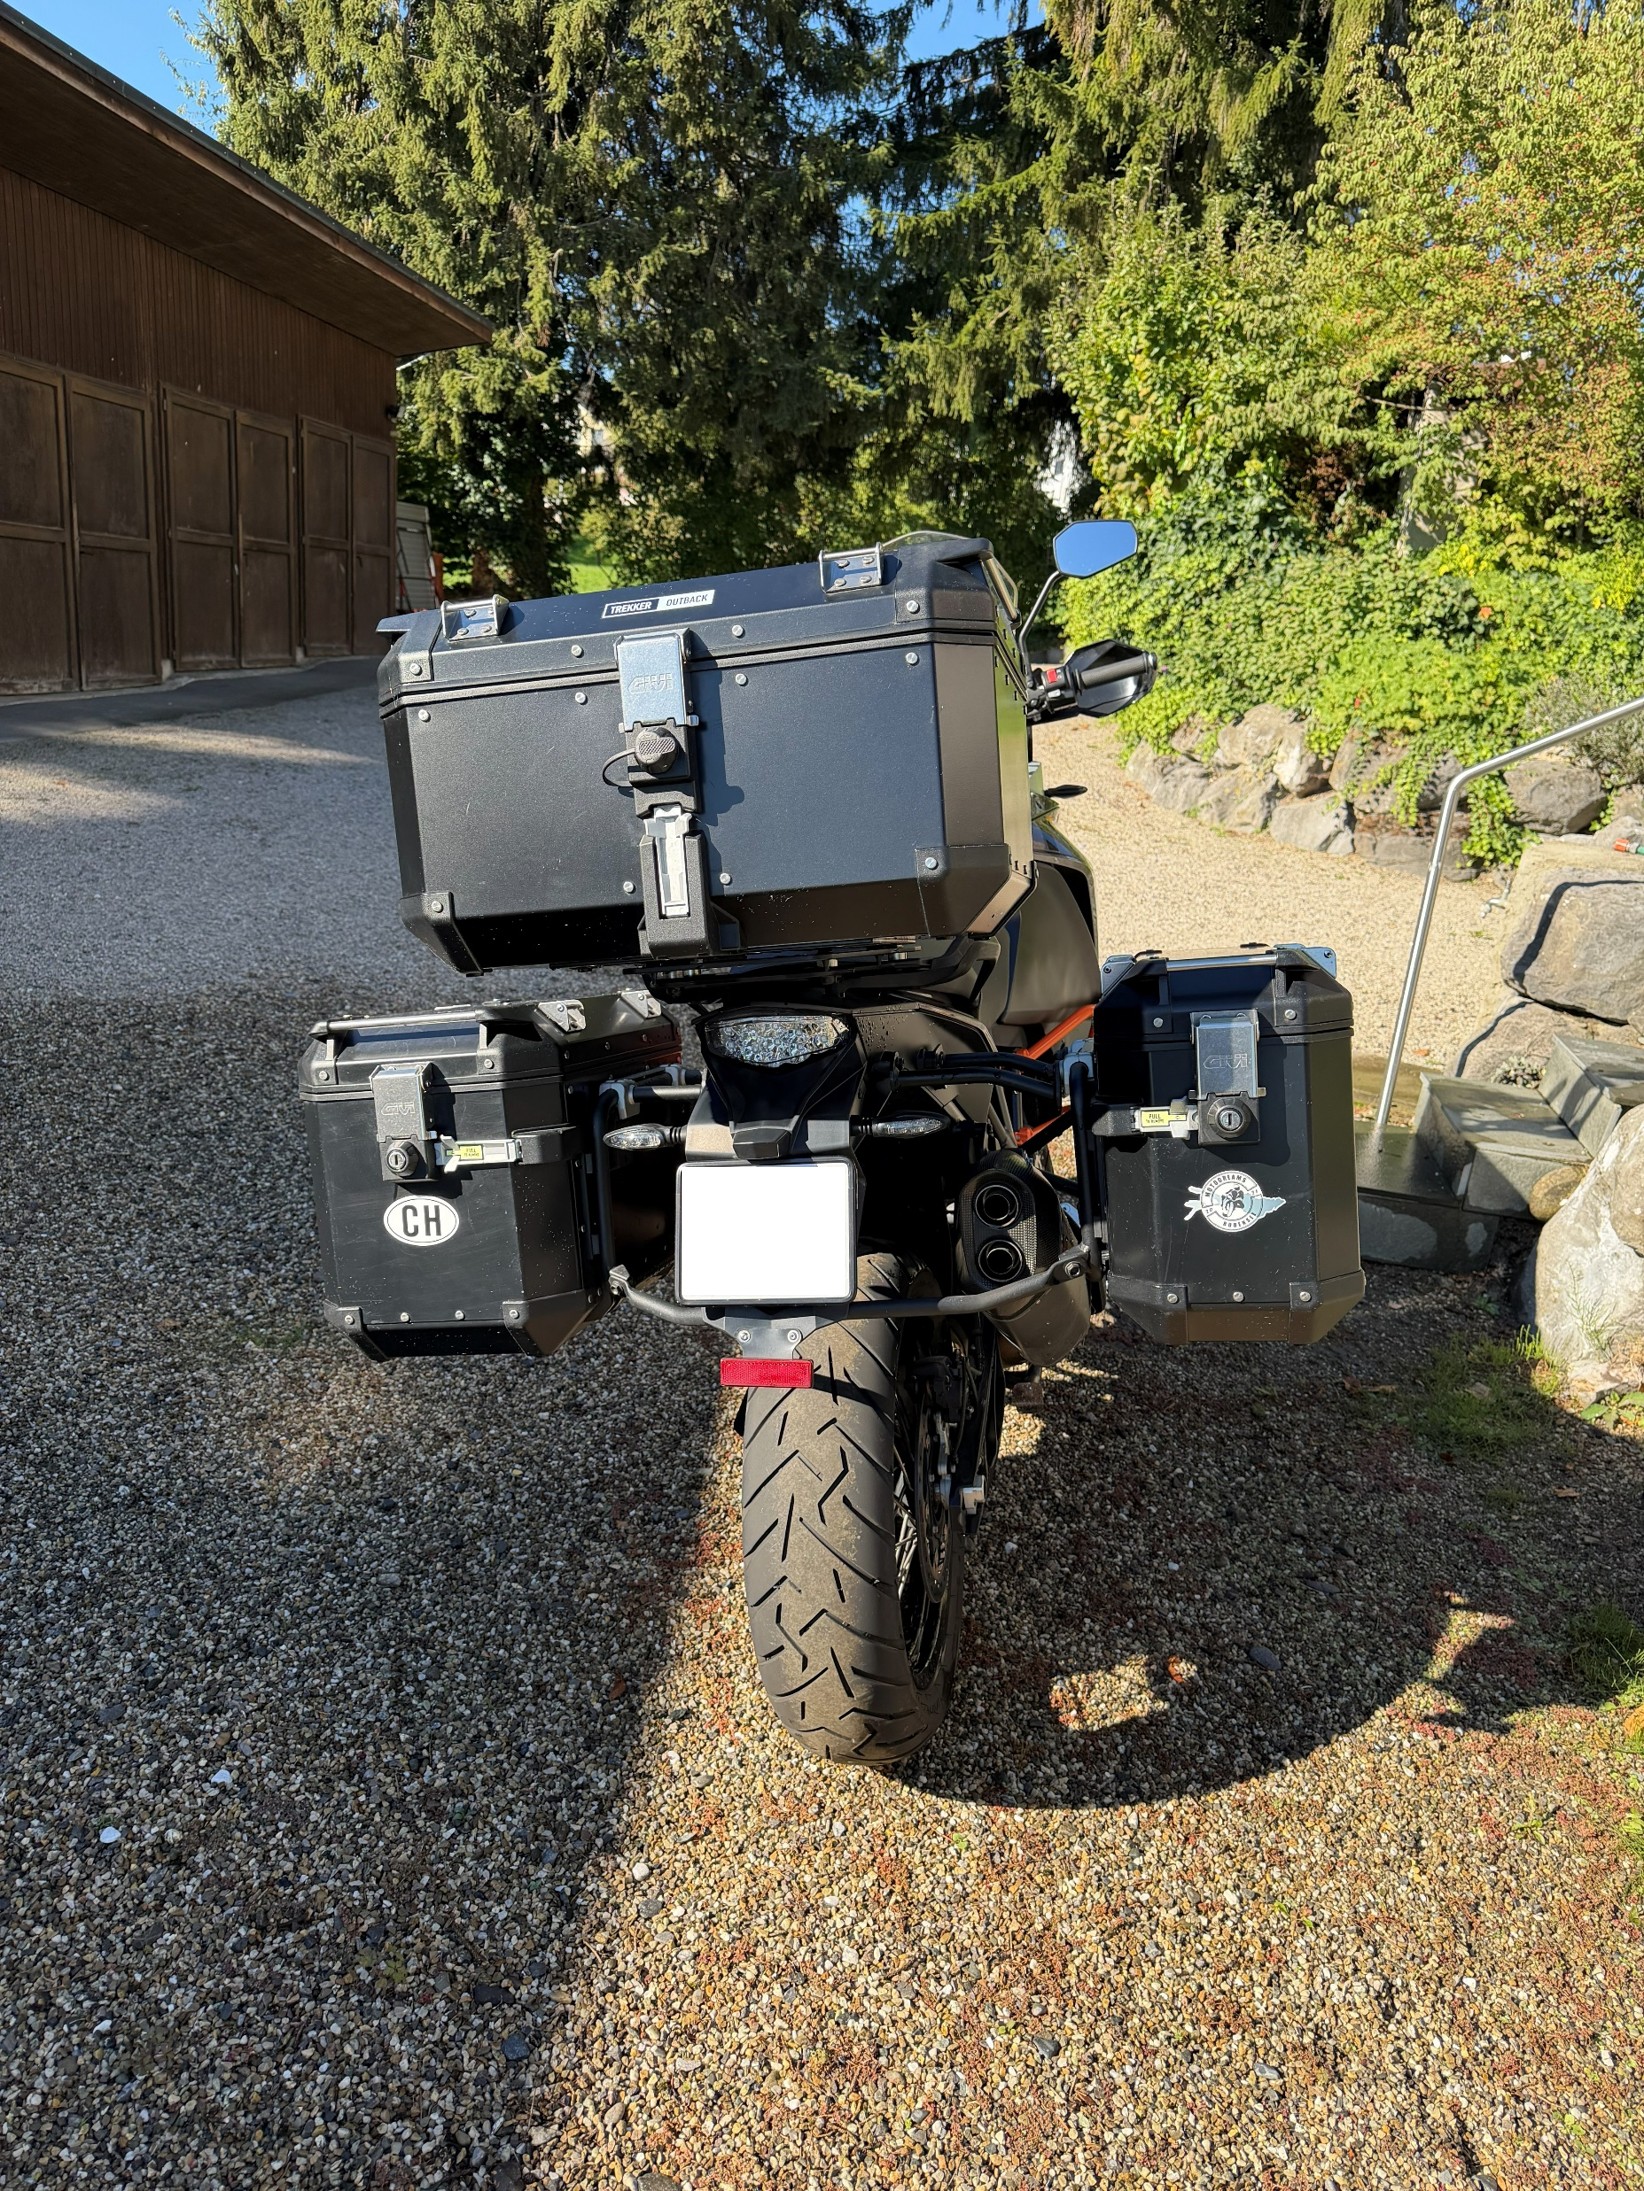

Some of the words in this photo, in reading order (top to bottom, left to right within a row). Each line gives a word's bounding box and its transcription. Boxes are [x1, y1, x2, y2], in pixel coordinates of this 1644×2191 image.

[610, 601, 652, 615] TREKKER
[666, 594, 708, 607] OUTBACK
[401, 1204, 442, 1238] CH
